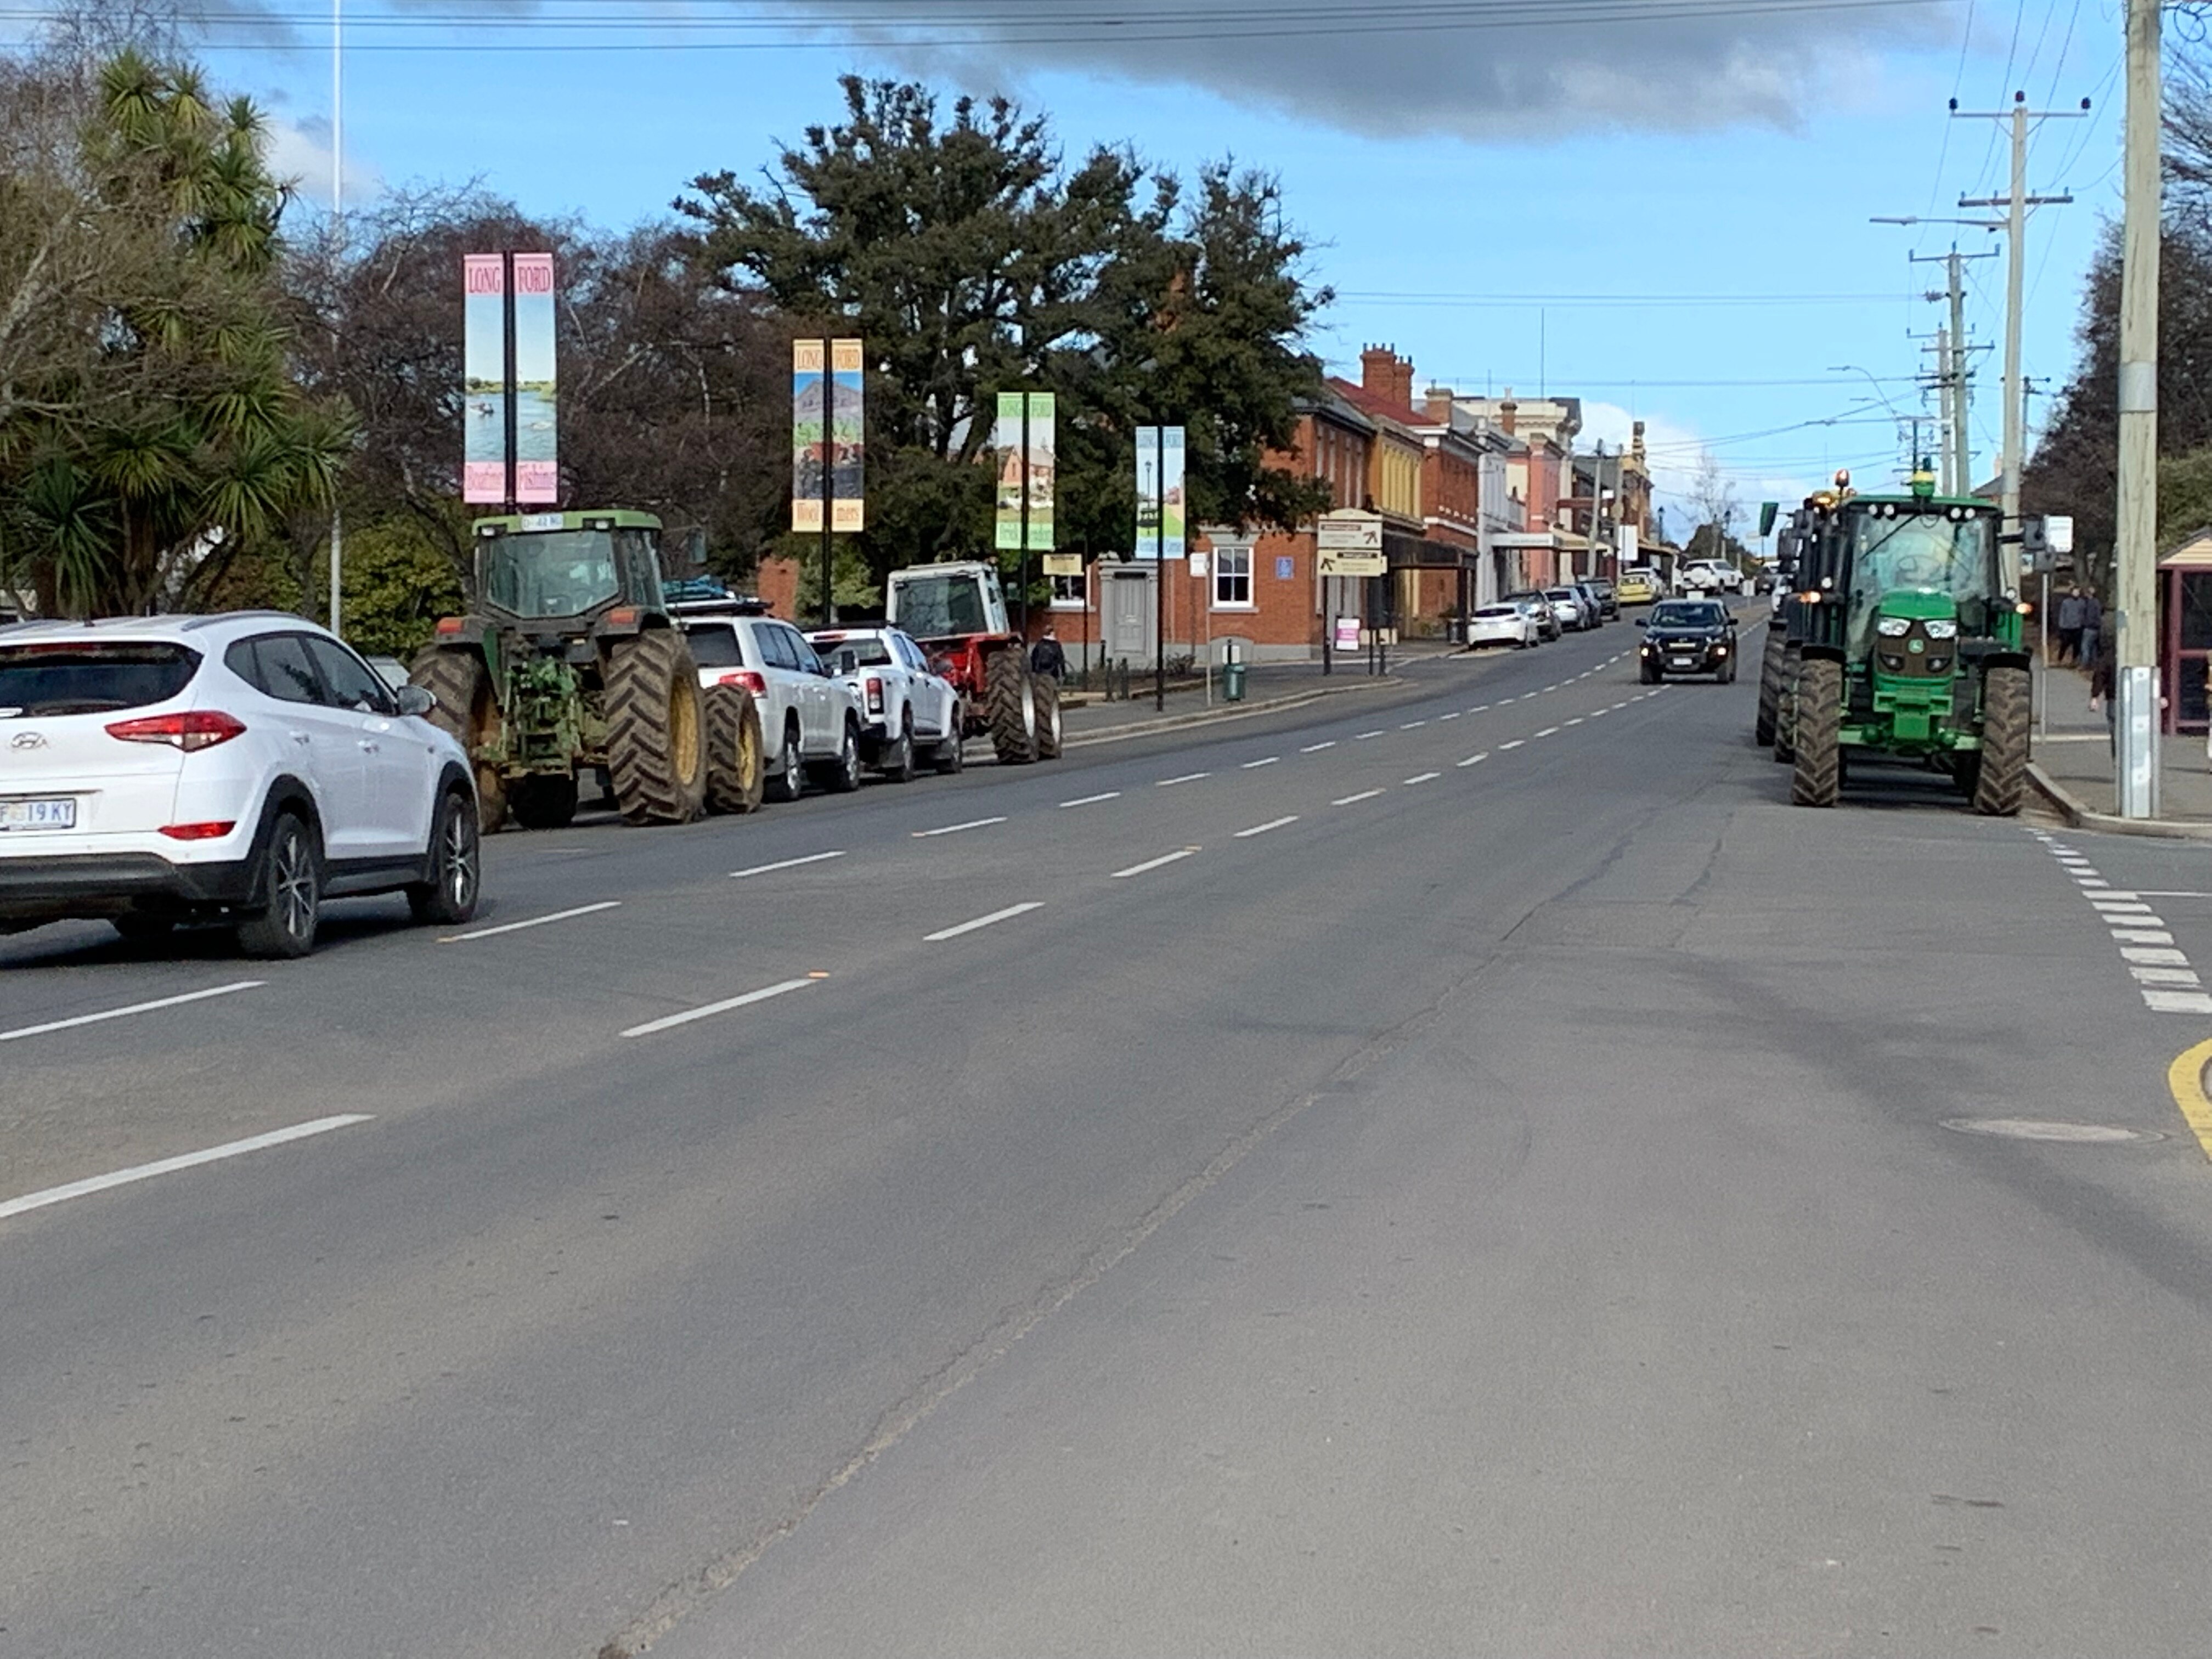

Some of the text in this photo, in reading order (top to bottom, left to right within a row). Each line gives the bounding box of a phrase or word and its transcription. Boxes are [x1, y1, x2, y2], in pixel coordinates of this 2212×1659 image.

[469, 266, 550, 293] LONG FORD
[52, 802, 71, 821] KY
